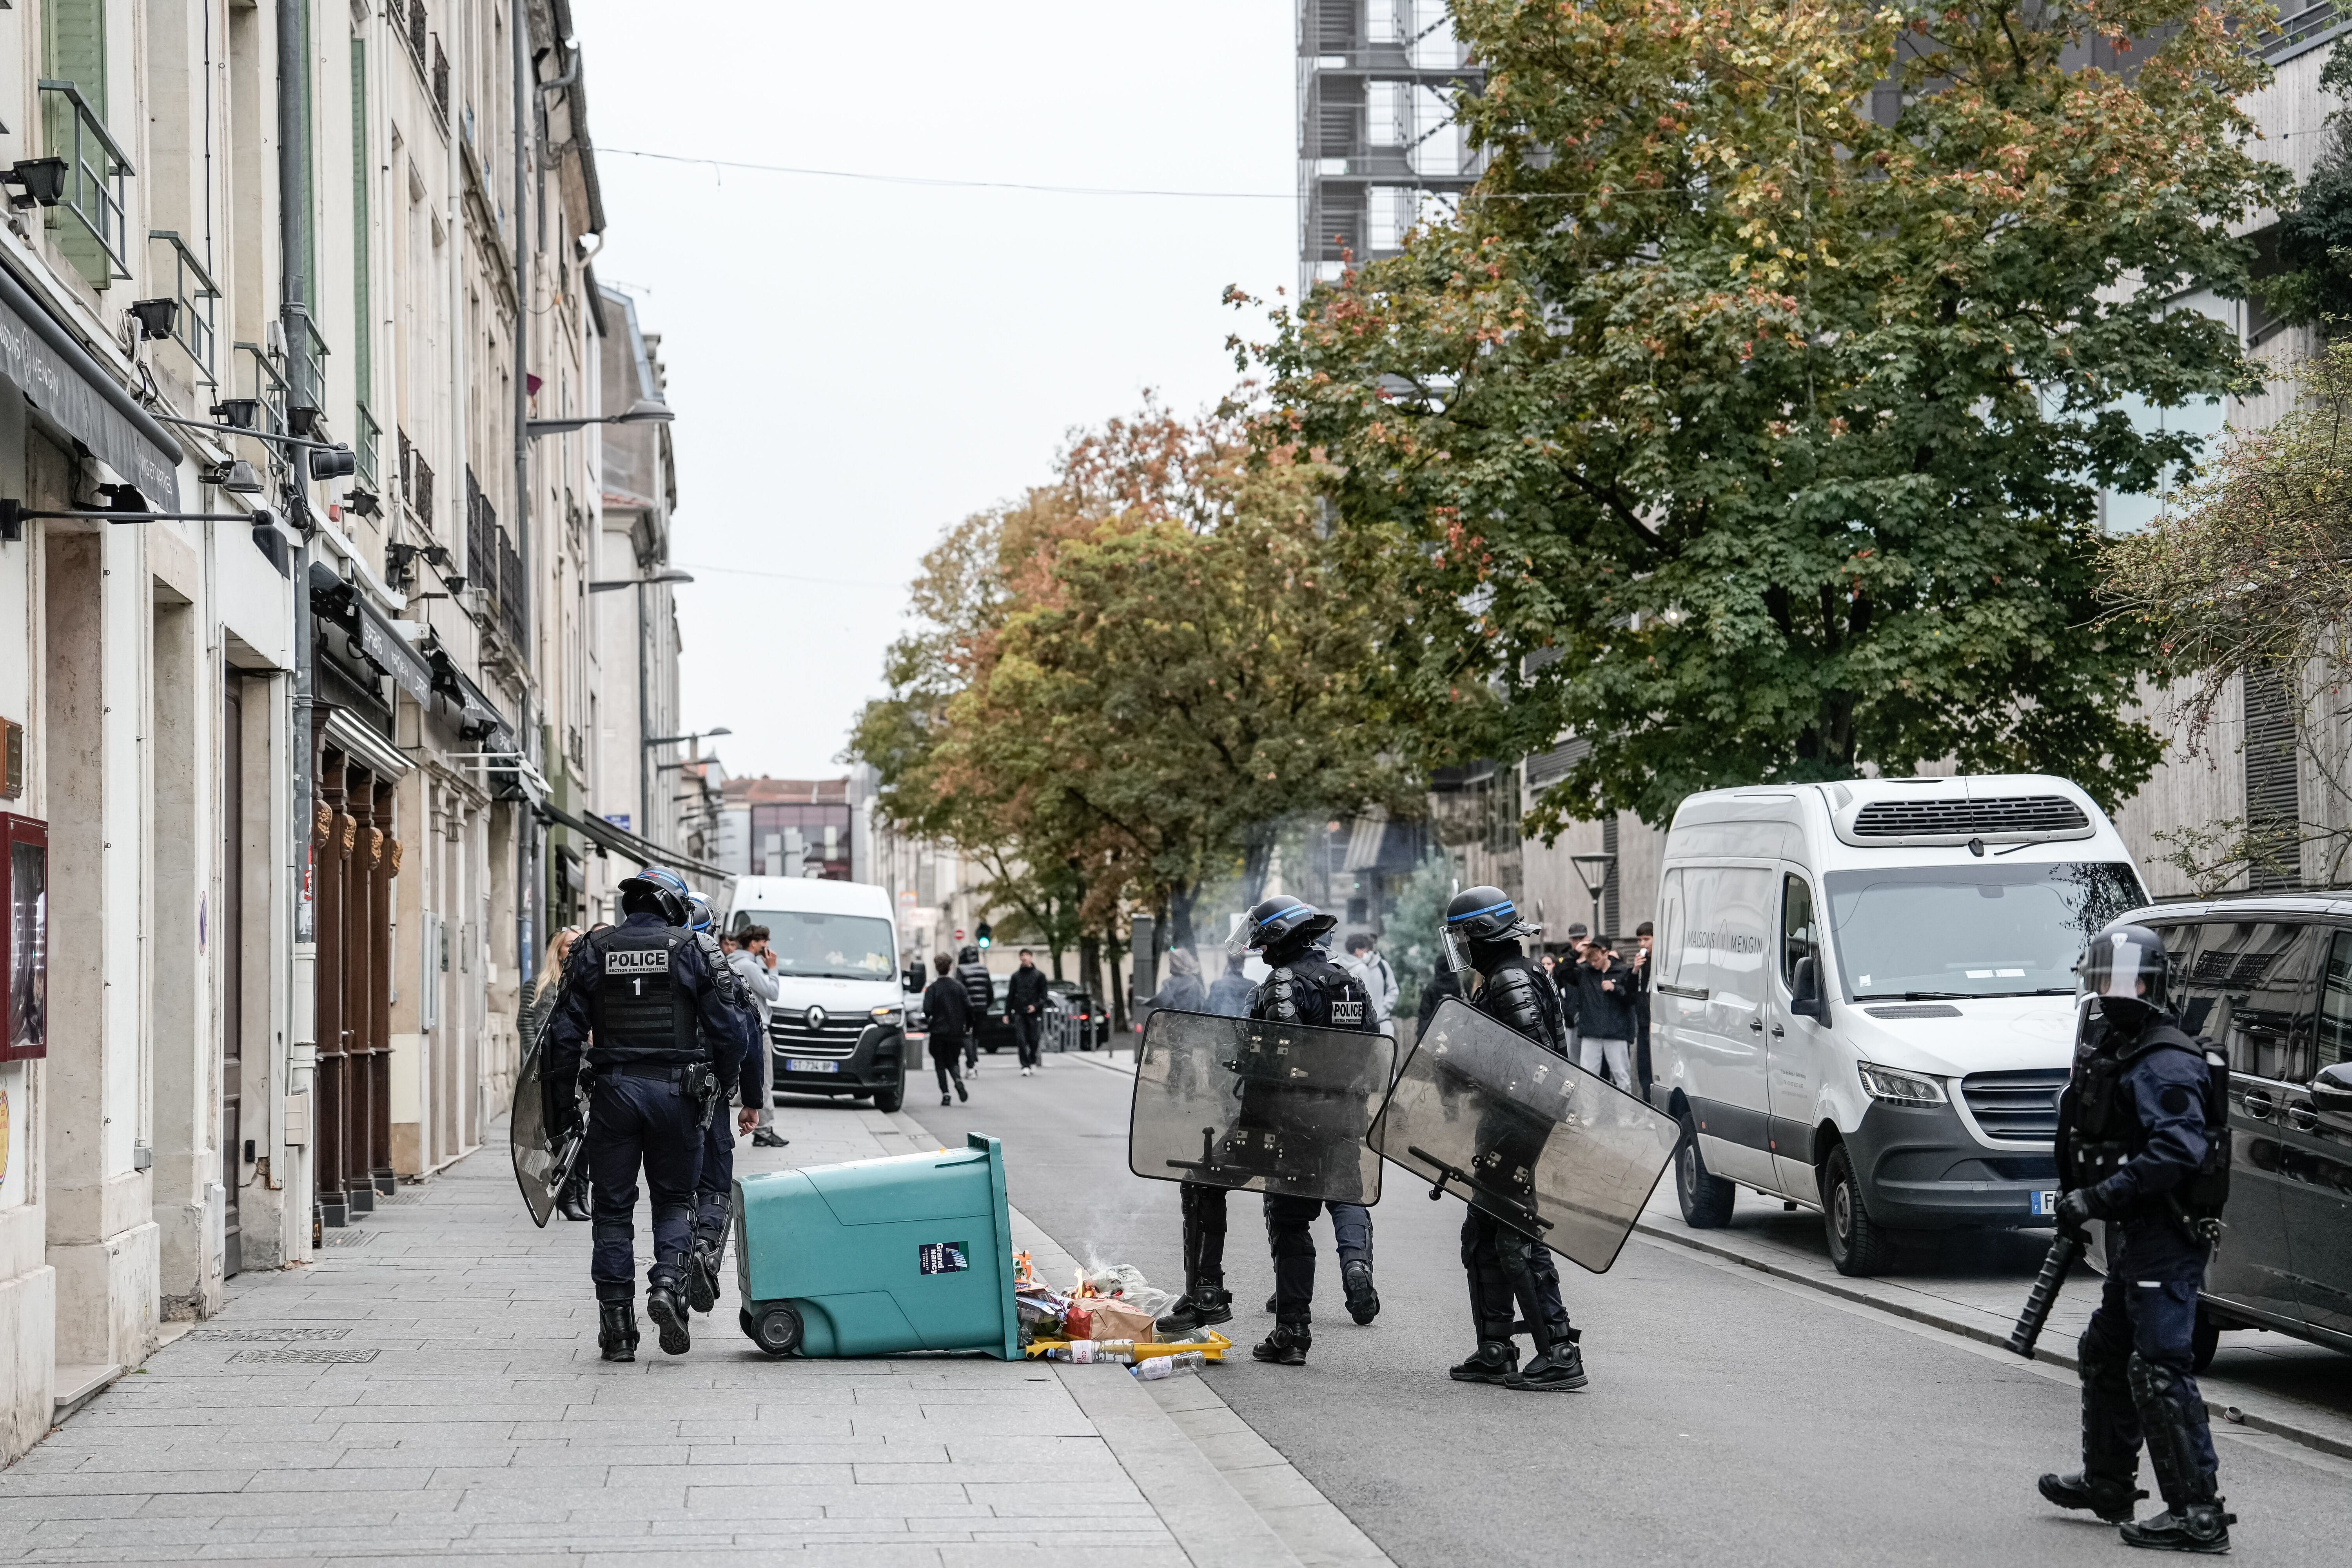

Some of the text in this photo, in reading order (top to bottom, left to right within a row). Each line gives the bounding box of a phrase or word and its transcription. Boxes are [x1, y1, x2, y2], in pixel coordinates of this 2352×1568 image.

[1687, 930, 1715, 949] MAISONS
[1730, 935, 1763, 955] MENGIN
[608, 953, 665, 967] POLICE
[633, 978, 641, 995] 1
[1344, 985, 1350, 1001] 1
[1334, 1004, 1362, 1017] POLICE
